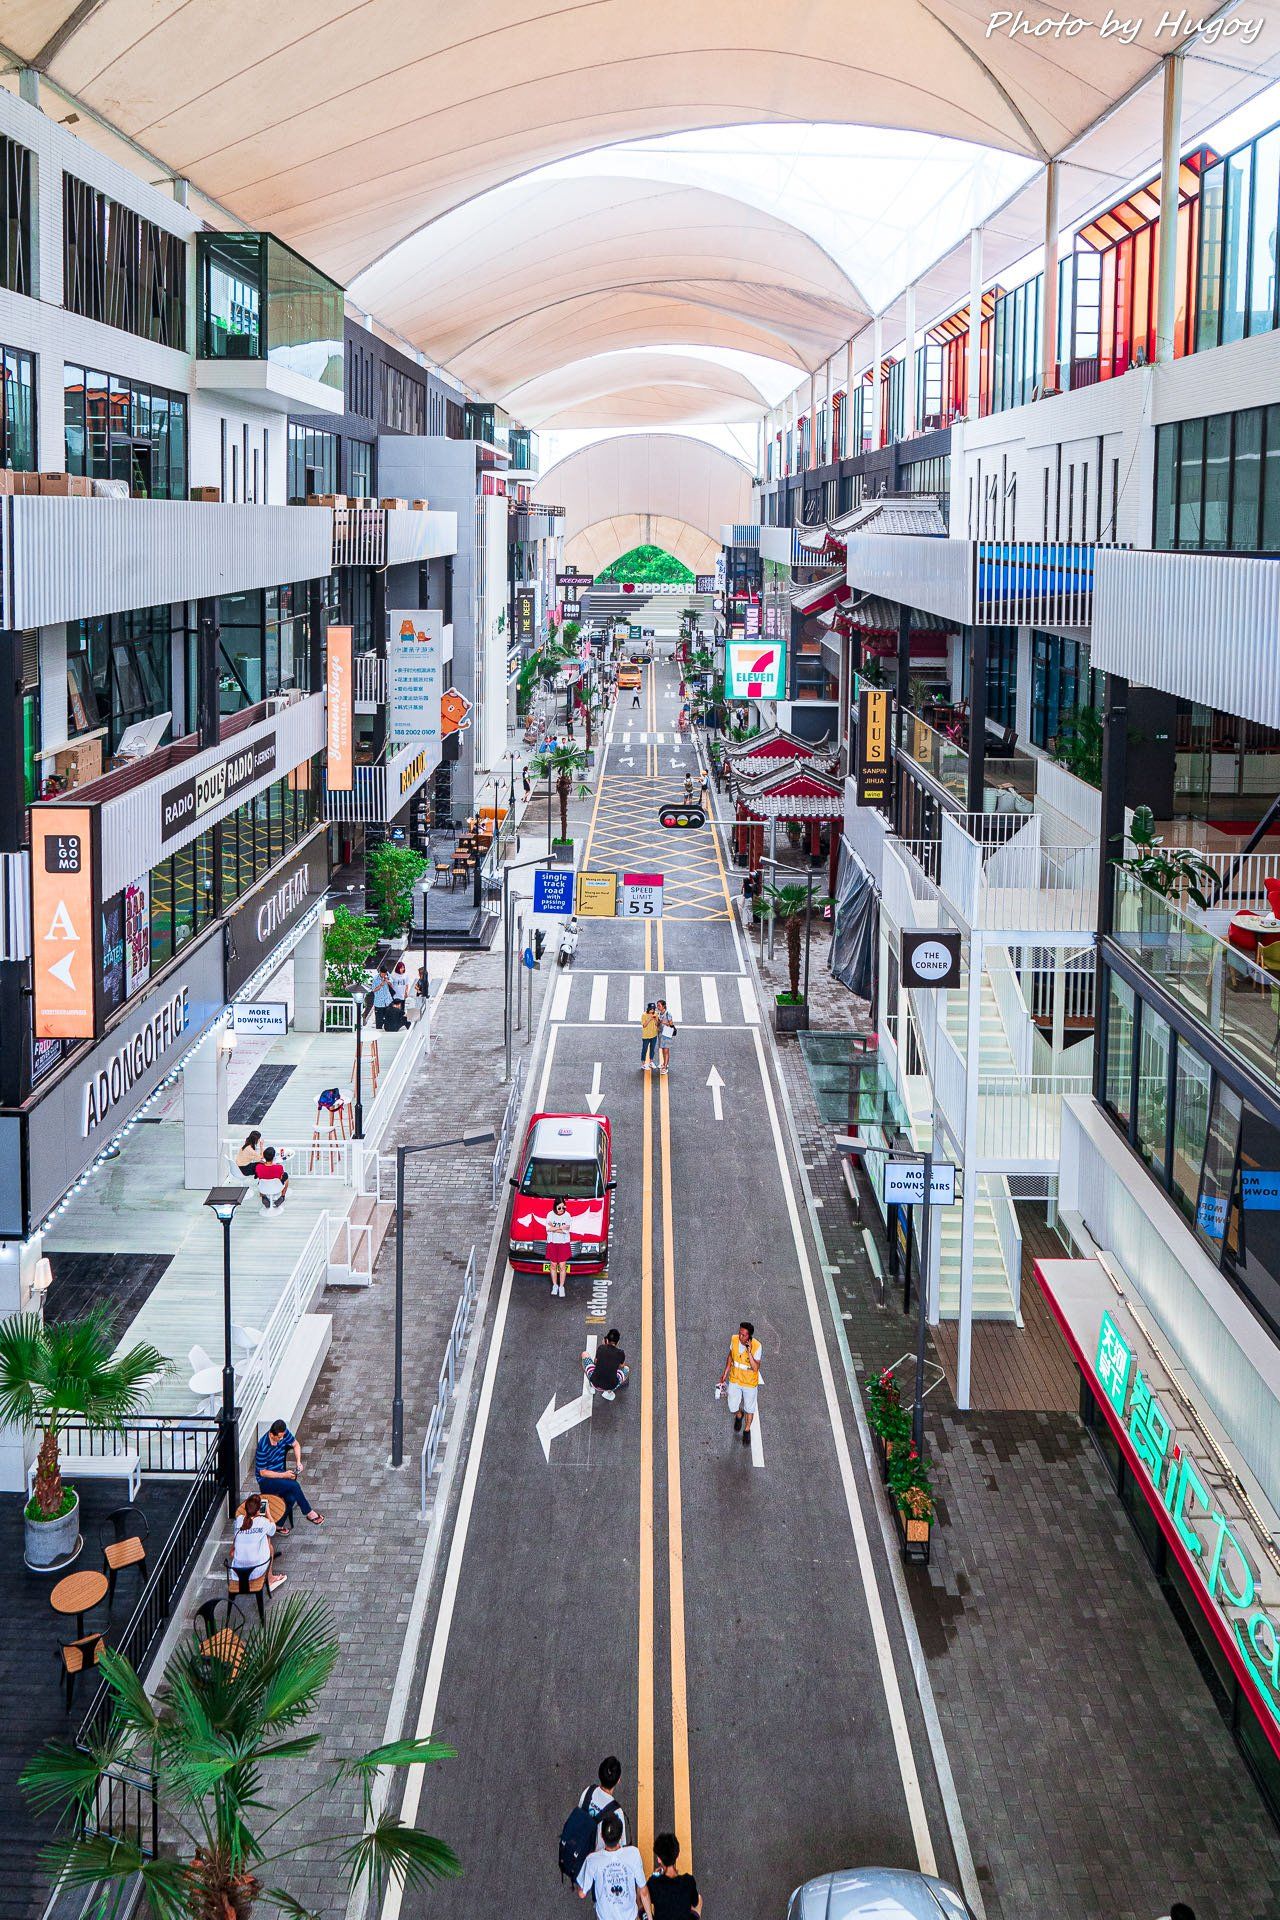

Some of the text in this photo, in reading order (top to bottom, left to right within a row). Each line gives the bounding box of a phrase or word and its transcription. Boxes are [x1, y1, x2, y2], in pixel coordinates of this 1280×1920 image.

[563, 604, 579, 612] FOOD
[871, 692, 882, 758] PLUS
[165, 793, 194, 825] RADIO
[227, 751, 253, 788] RADIO
[541, 873, 568, 882] single
[630, 886, 653, 894] SPEED
[541, 899, 566, 907] passing
[629, 901, 654, 914] 55
[43, 900, 81, 941] A
[915, 961, 948, 969] CORNER
[82, 985, 190, 1138] ADONGOFFICE
[905, 1171, 934, 1180] MOE
[890, 1181, 950, 1191] DOWNSAIRS
